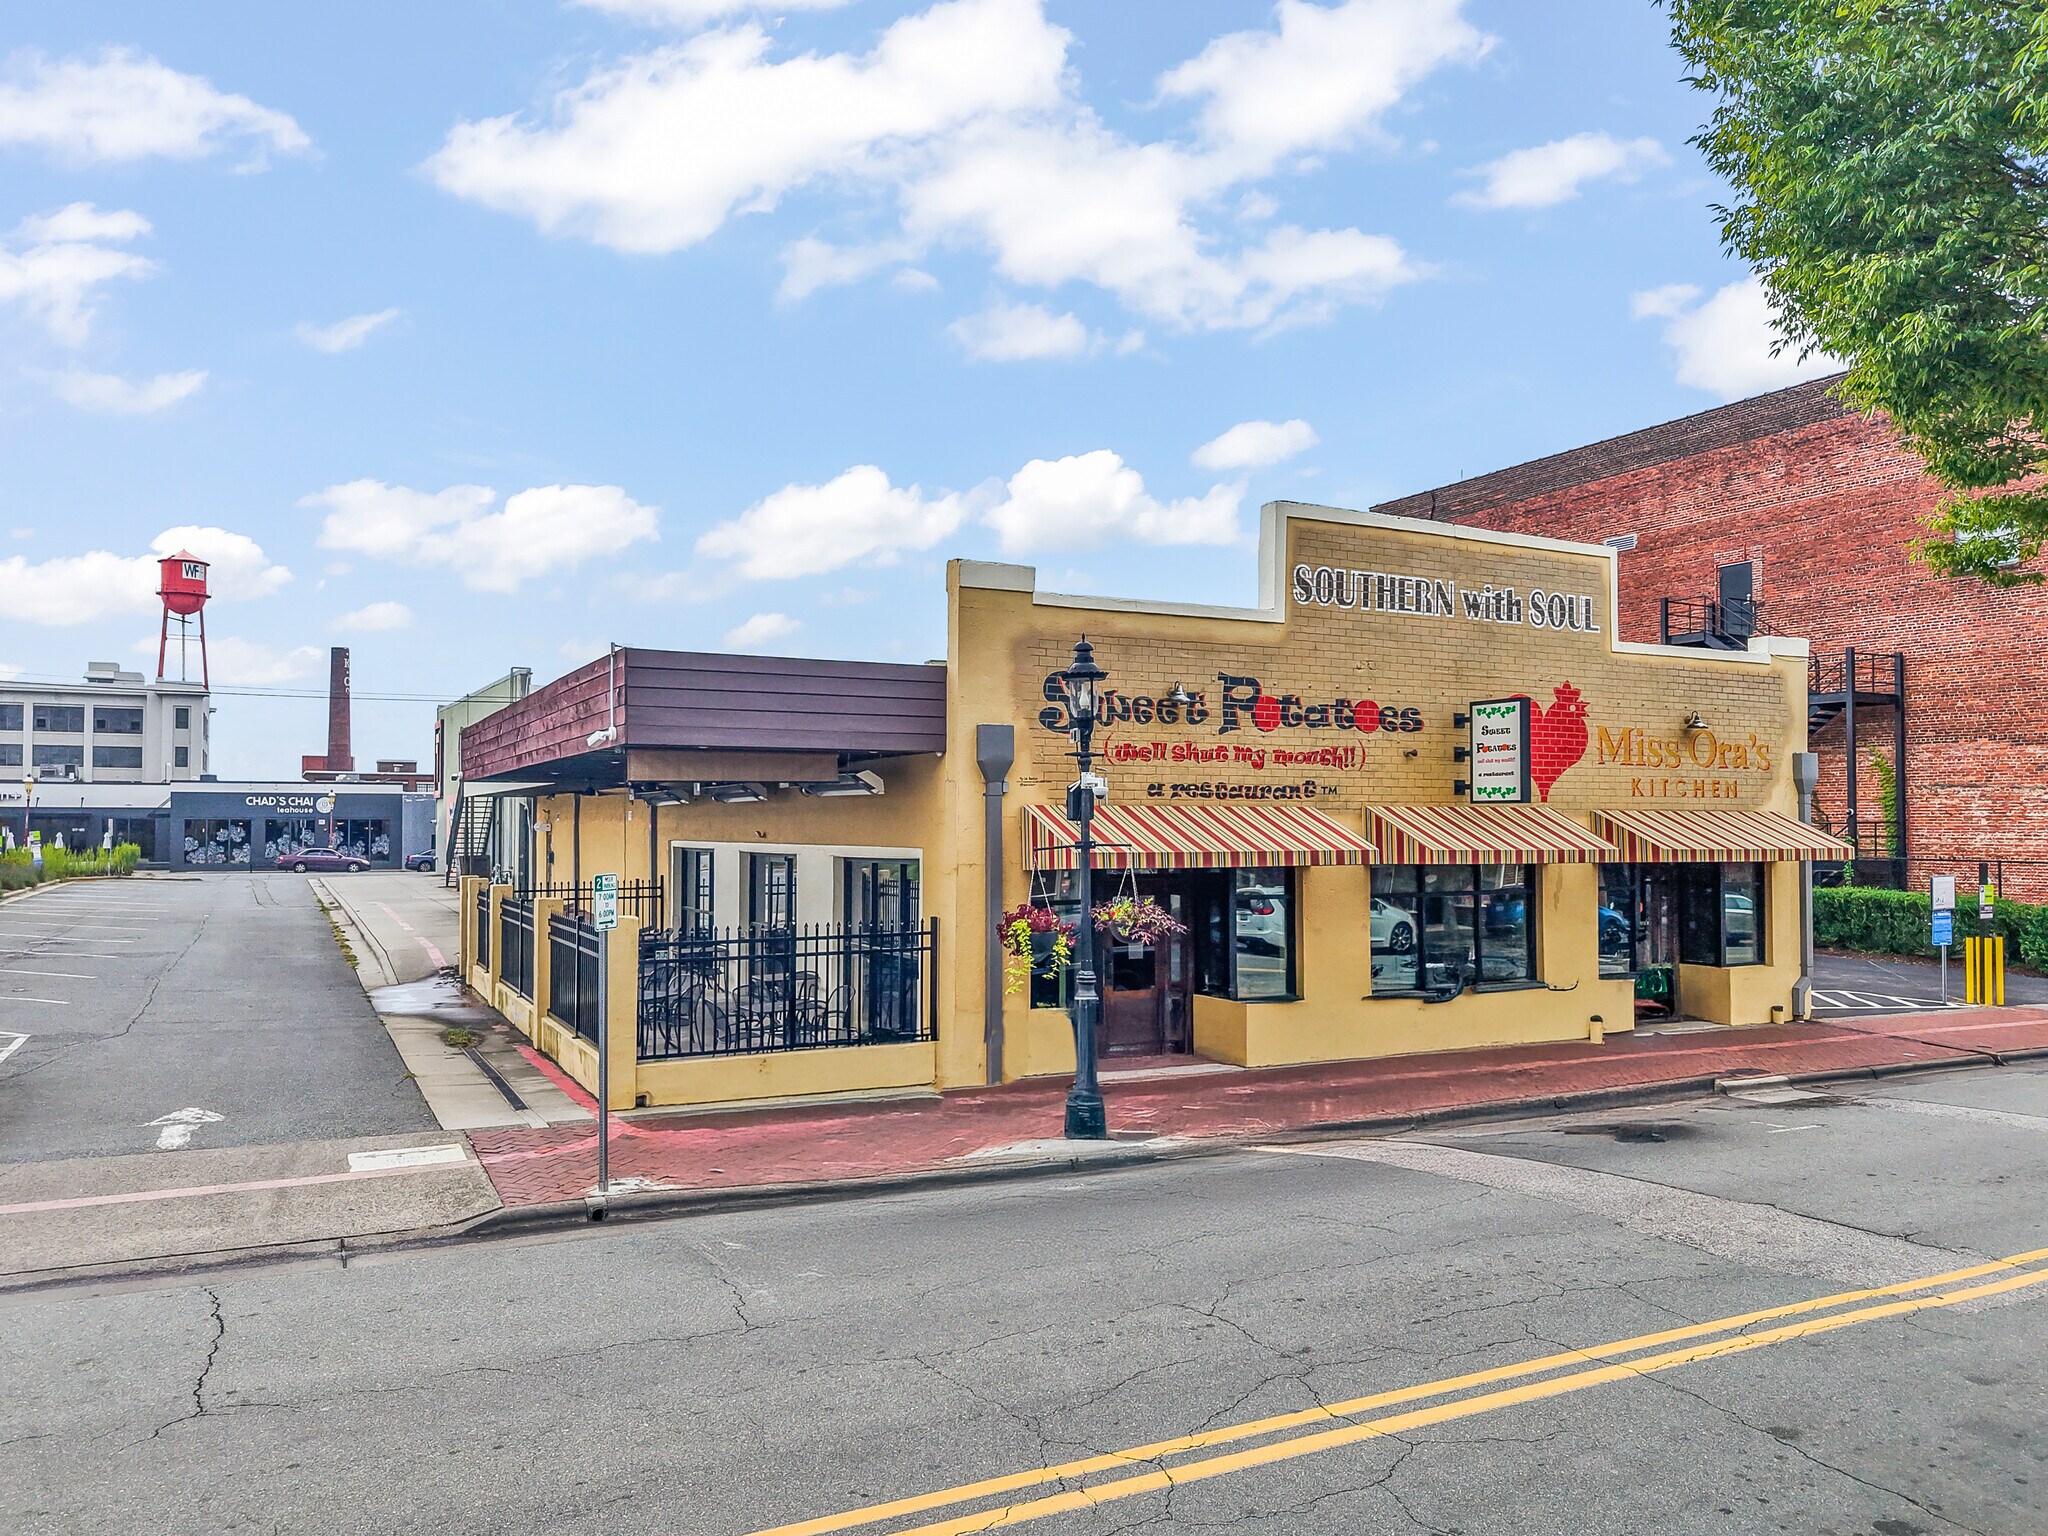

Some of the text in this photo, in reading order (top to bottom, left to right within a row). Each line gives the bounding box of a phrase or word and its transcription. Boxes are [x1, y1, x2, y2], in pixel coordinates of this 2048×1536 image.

[184, 563, 199, 578] WF
[1292, 564, 1600, 633] SOUTHERN with SOUL
[1038, 670, 1424, 735] Sweet Potatoes
[1172, 740, 1228, 765] shut
[1233, 745, 1266, 770] my
[1595, 725, 1771, 771] Miss Ora's
[1147, 783, 1165, 797] a
[1170, 779, 1317, 799] restaurant
[1631, 778, 1738, 798] KITCHEN
[245, 796, 314, 806] CHAD'S CHAI
[596, 878, 602, 889] 2
